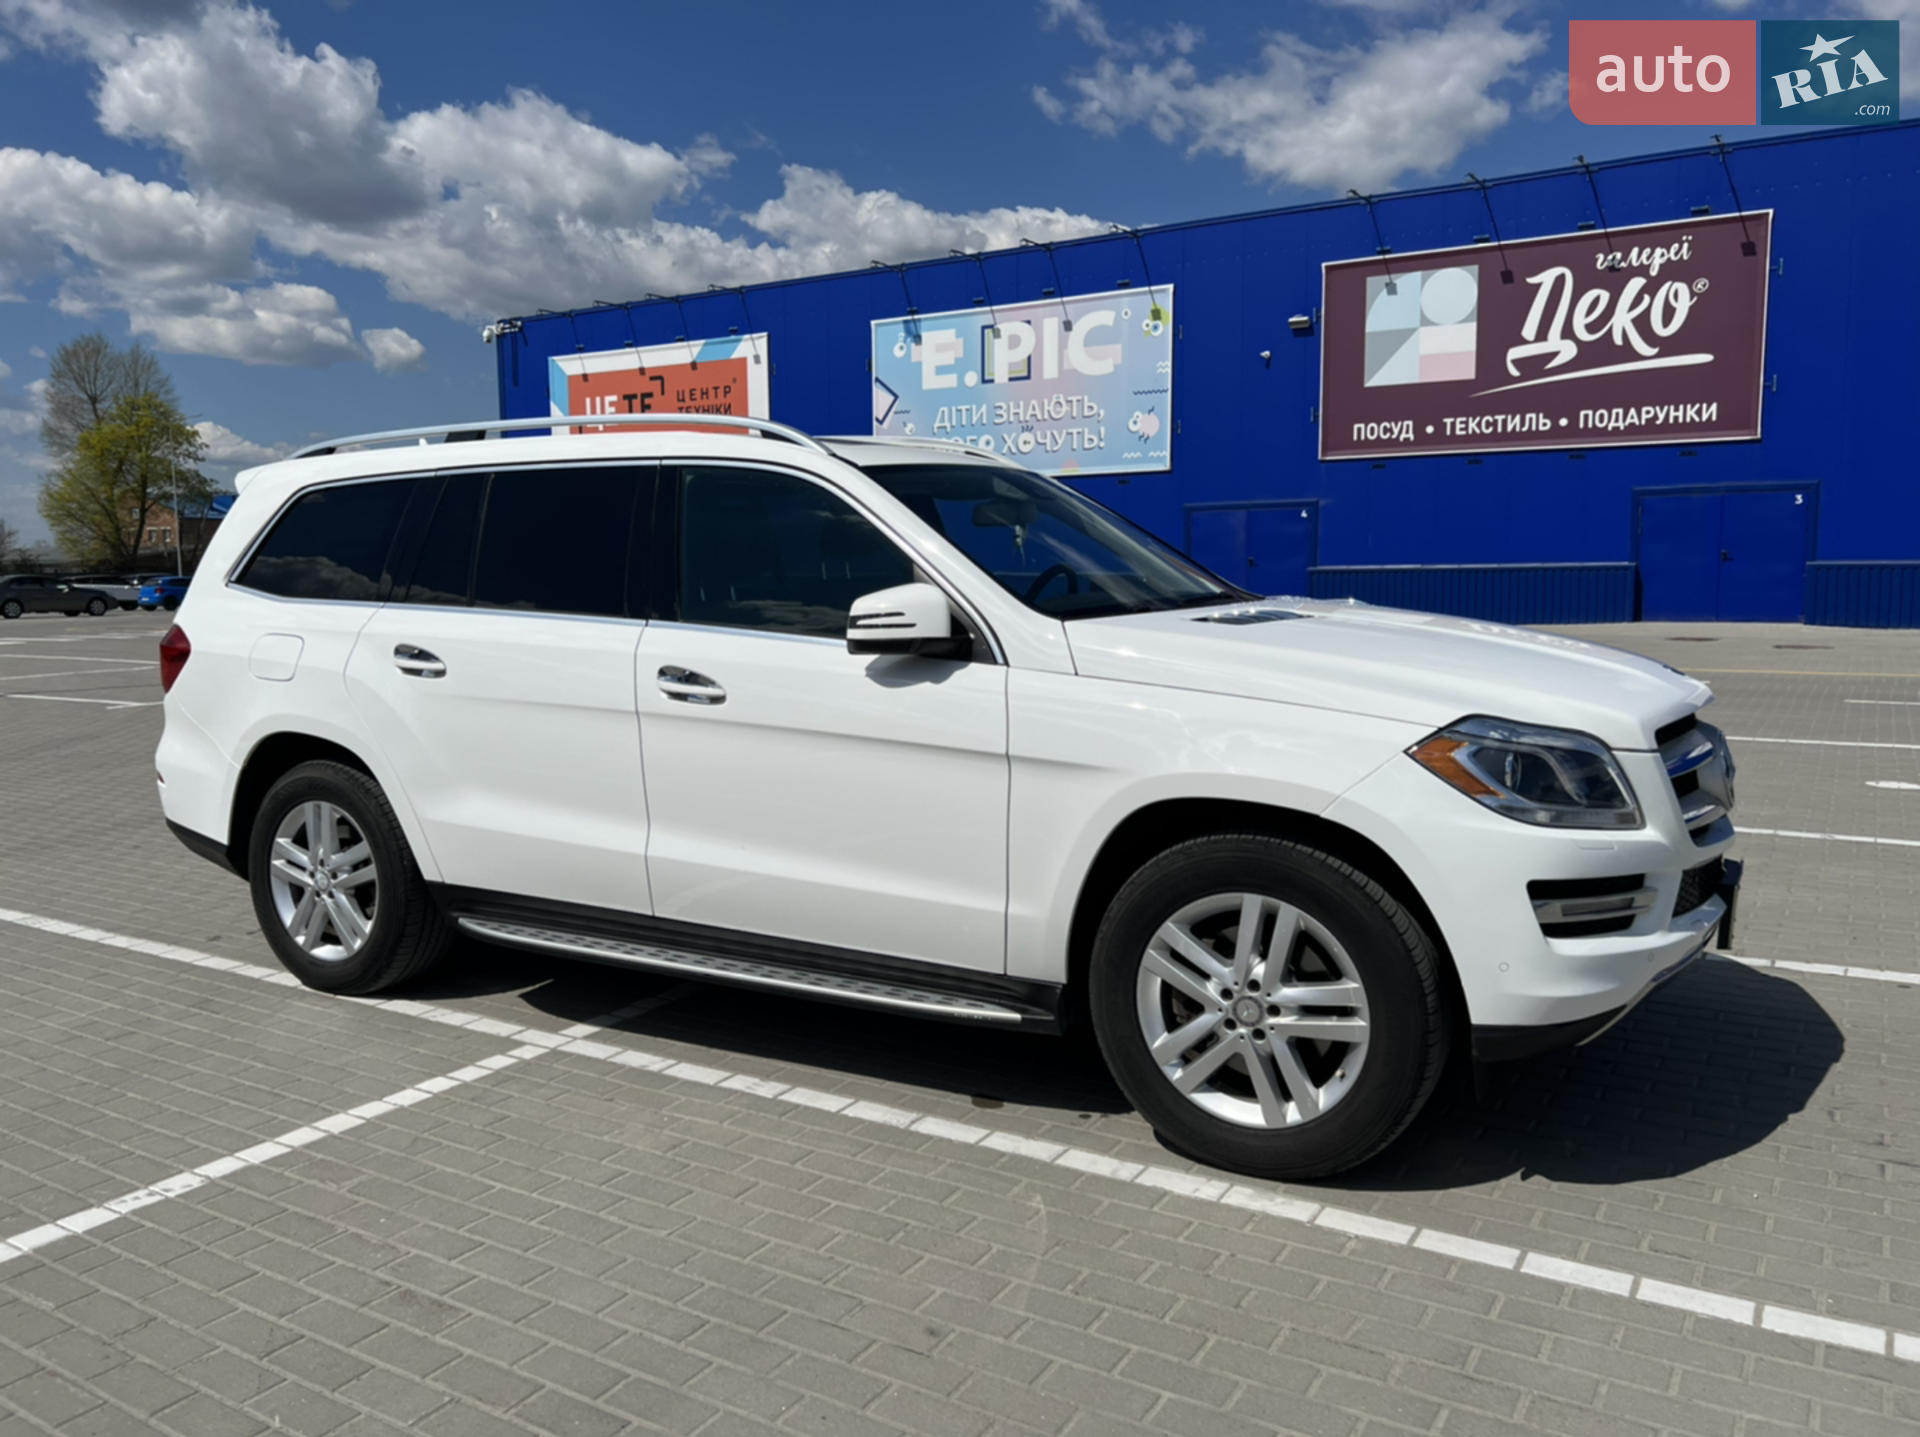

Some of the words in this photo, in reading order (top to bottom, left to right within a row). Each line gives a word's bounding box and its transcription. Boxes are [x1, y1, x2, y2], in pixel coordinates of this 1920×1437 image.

[921, 310, 1116, 390] E.PIC
[676, 385, 732, 403] ЦЕНТР
[933, 403, 988, 434] ДІТИ
[1353, 420, 1415, 441] ПОСУД
[1444, 412, 1552, 436] ТЕКСТИЛЬ
[1578, 402, 1718, 430] ПОДАРУНКИ
[1794, 493, 1804, 505] 3
